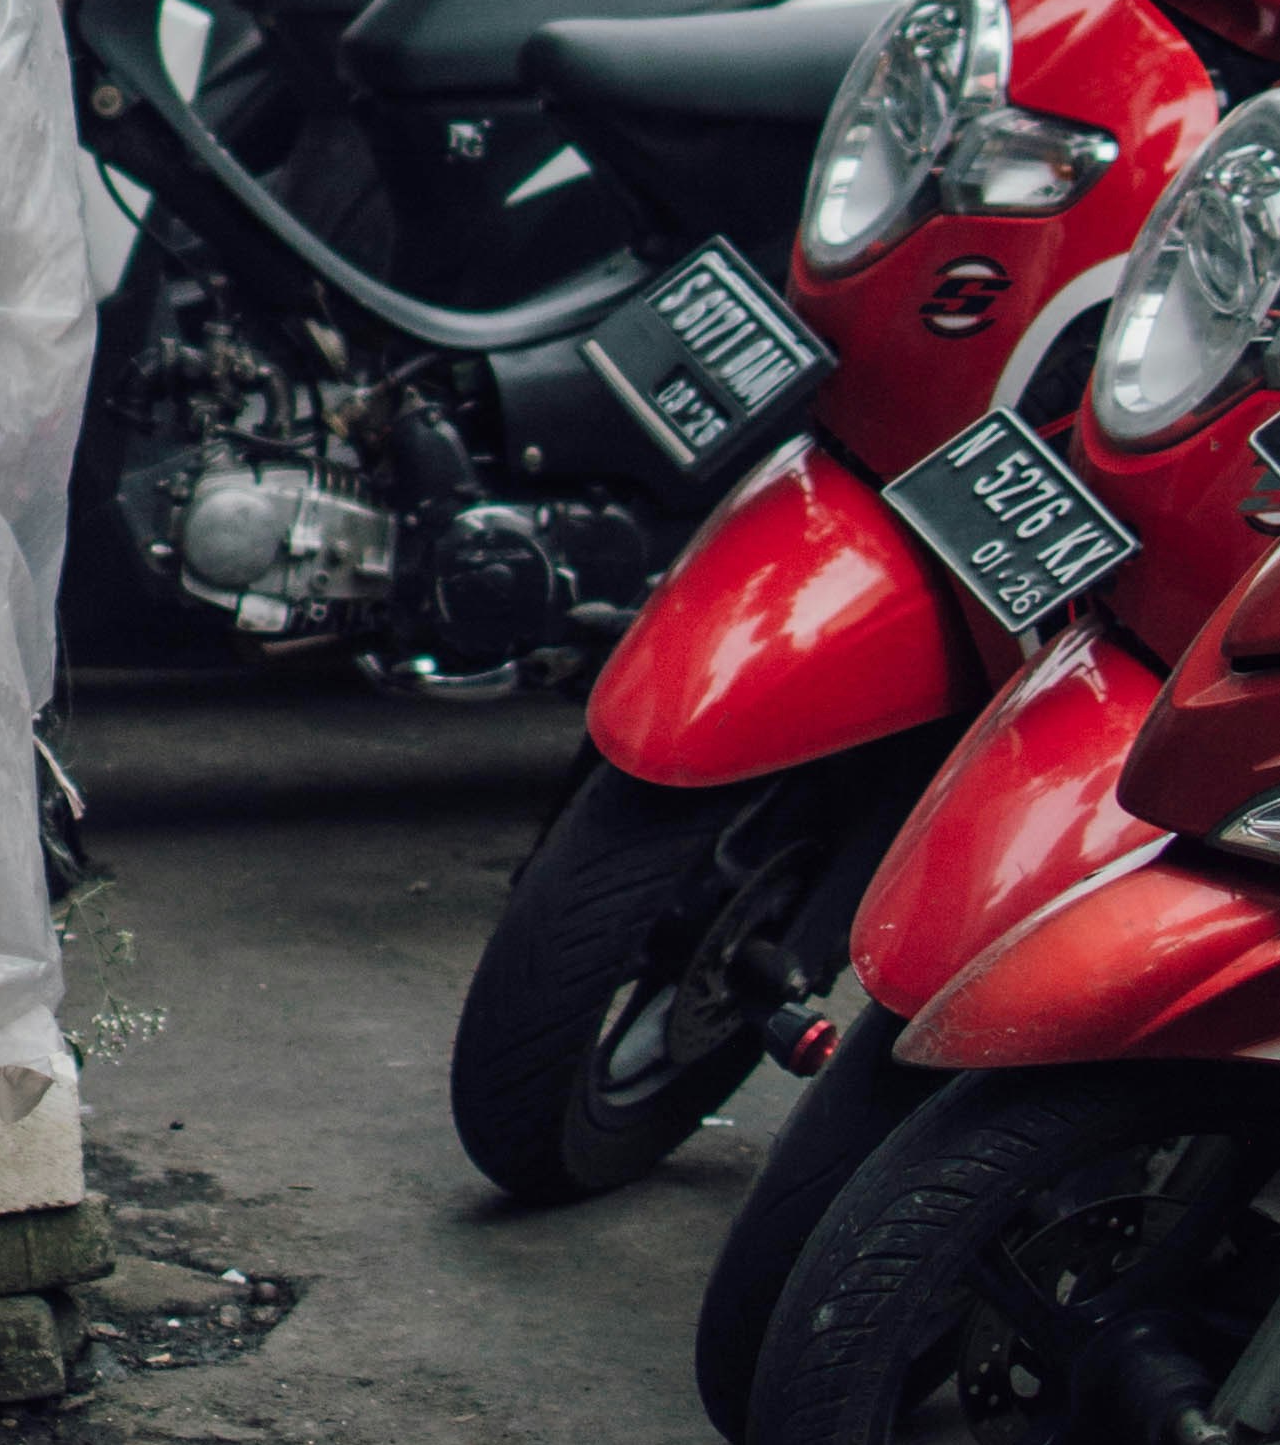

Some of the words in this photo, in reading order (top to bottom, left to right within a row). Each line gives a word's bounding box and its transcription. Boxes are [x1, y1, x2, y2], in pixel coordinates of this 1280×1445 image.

[946, 422, 1007, 468] N
[973, 449, 1074, 539] 5276
[1036, 520, 1115, 585] KX
